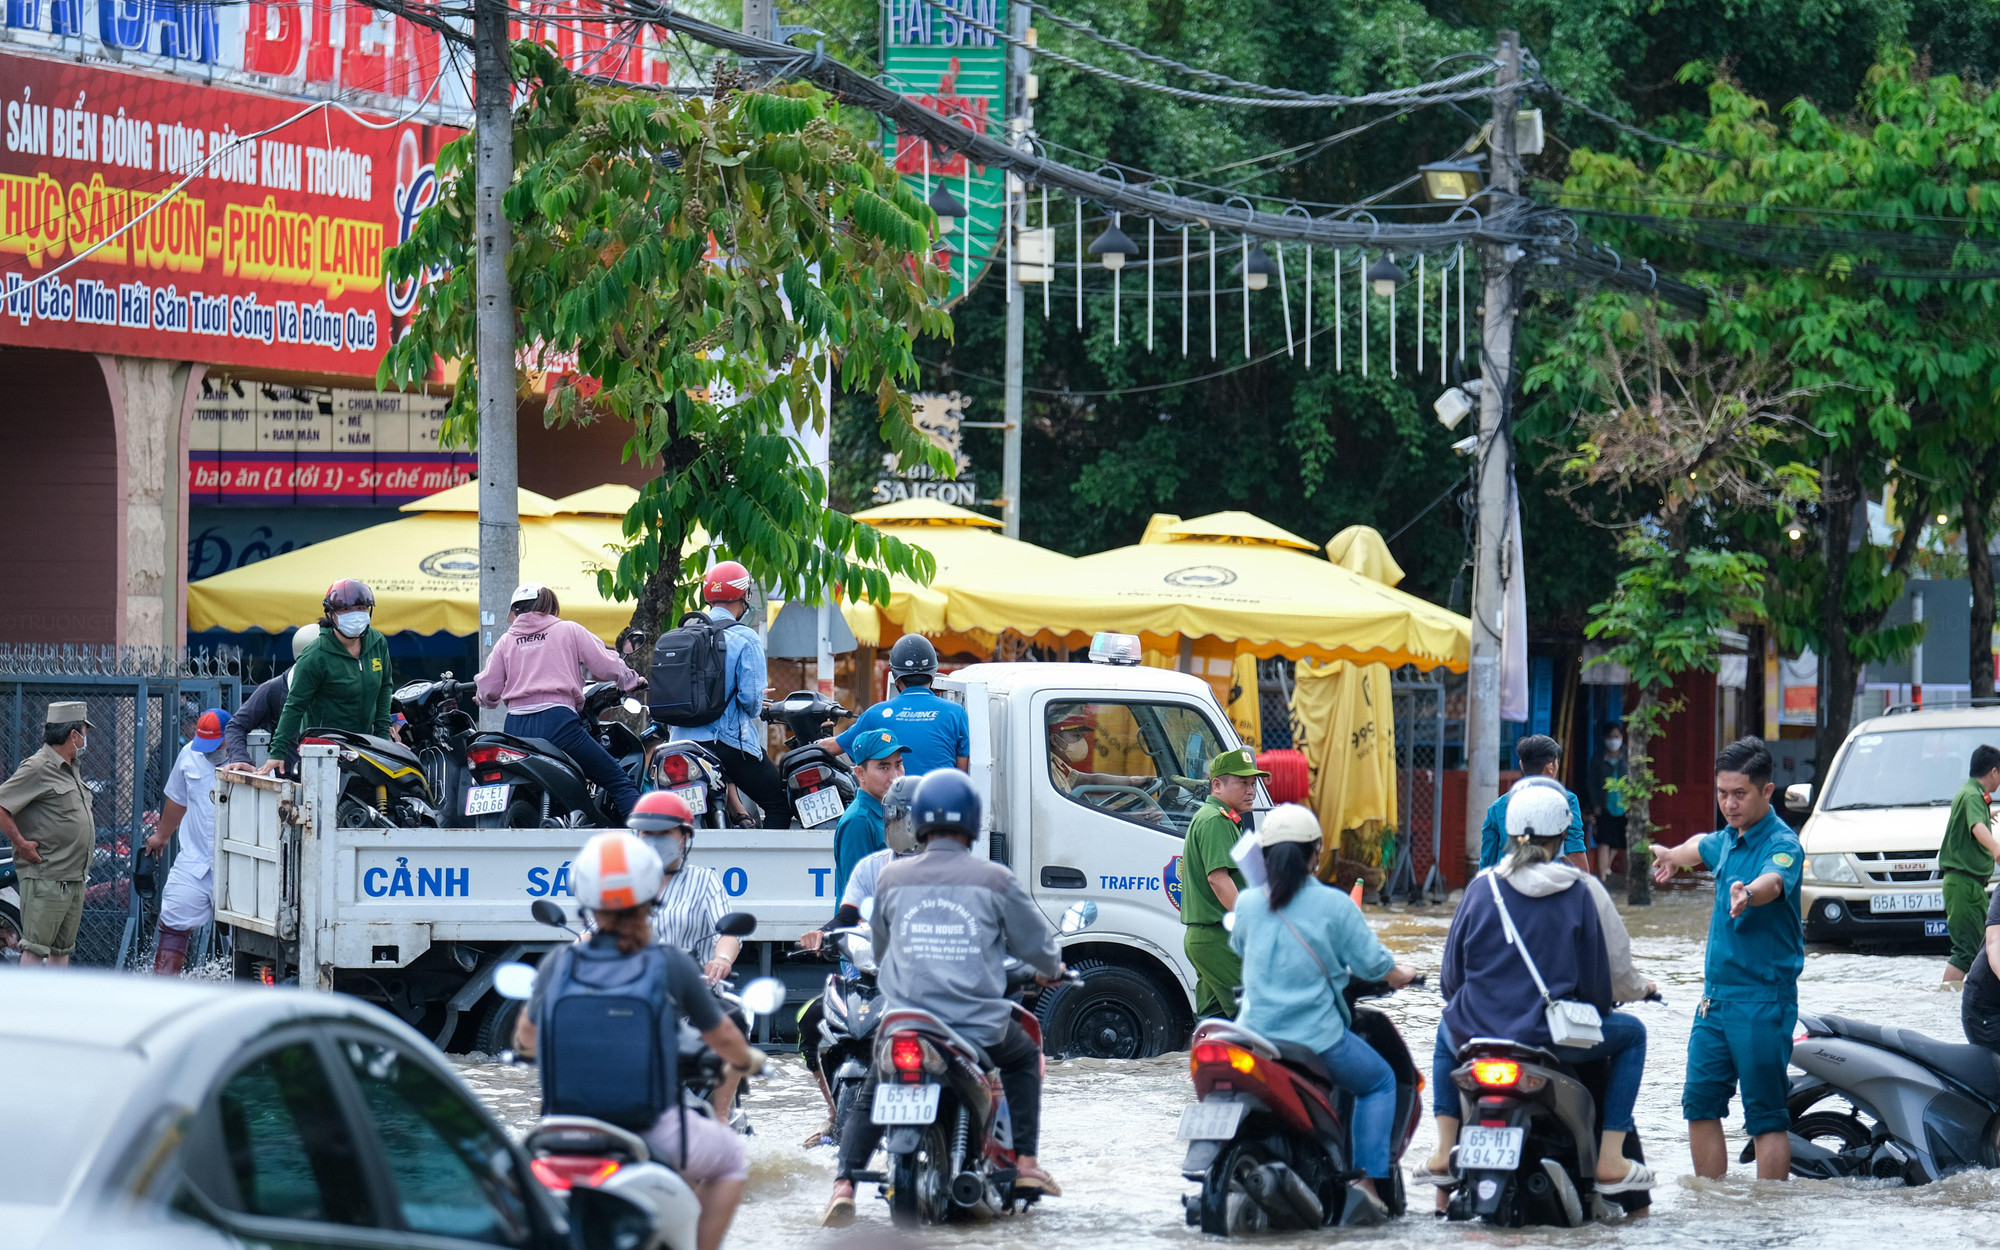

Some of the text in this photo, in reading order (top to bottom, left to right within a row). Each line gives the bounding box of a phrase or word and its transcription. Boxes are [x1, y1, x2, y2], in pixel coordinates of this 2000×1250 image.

[6, 86, 47, 155] SẢN
[52, 90, 97, 162] BIỂN
[102, 107, 152, 170] ĐÔNG
[261, 139, 302, 191] KHAI
[68, 172, 127, 262] SÂN
[313, 216, 383, 294] LẠNH
[6, 272, 377, 352] Vụ Các Món Hải Sản Tươi Sống Và Đồng Quê
[195, 468, 230, 487] bao
[235, 467, 260, 487] ăn
[288, 466, 320, 488] đổi
[357, 470, 384, 488] Sơ
[386, 467, 421, 488] chế
[872, 480, 977, 505] SAIGON
[896, 710, 940, 718] ADVANCE
[473, 786, 502, 800] 64-E1
[802, 791, 833, 812] 65-F7
[469, 799, 504, 814] 630.66
[806, 806, 838, 825] 1426
[363, 856, 577, 898] CẢNH SÁ
[1099, 875, 1160, 891] TRAFFIC
[911, 923, 965, 935] RICH HOUSE
[1926, 922, 1947, 935] TẬP
[1812, 1048, 1847, 1062] Janus
[880, 1104, 932, 1120] 111.10
[1470, 1130, 1511, 1147] 65-H1
[1462, 1148, 1516, 1166] 494.73
